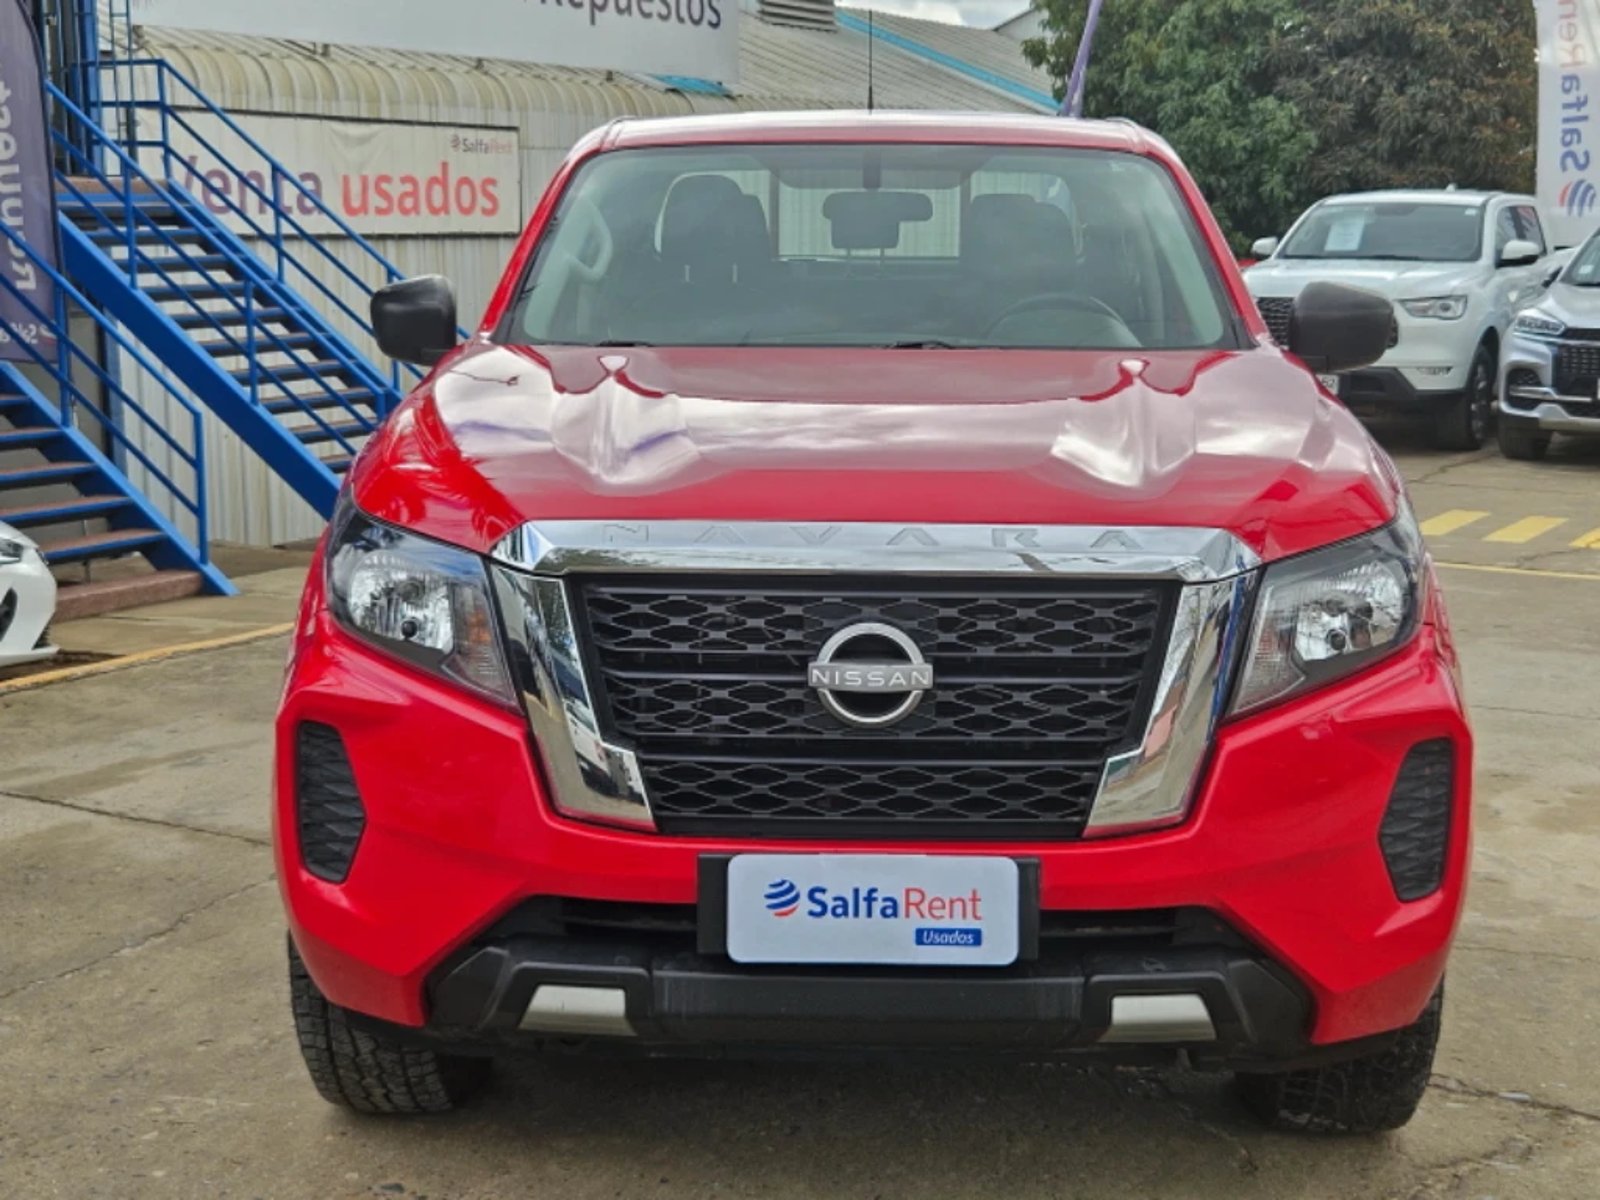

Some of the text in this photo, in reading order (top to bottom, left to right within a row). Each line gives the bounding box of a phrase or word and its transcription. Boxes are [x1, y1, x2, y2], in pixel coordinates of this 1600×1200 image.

[540, 0, 722, 29] puestos
[341, 161, 499, 217] usados
[603, 524, 1142, 549] NAVARA
[811, 669, 930, 687] NISSAN
[807, 886, 982, 920] SalfaRent
[923, 930, 974, 945] Usados
